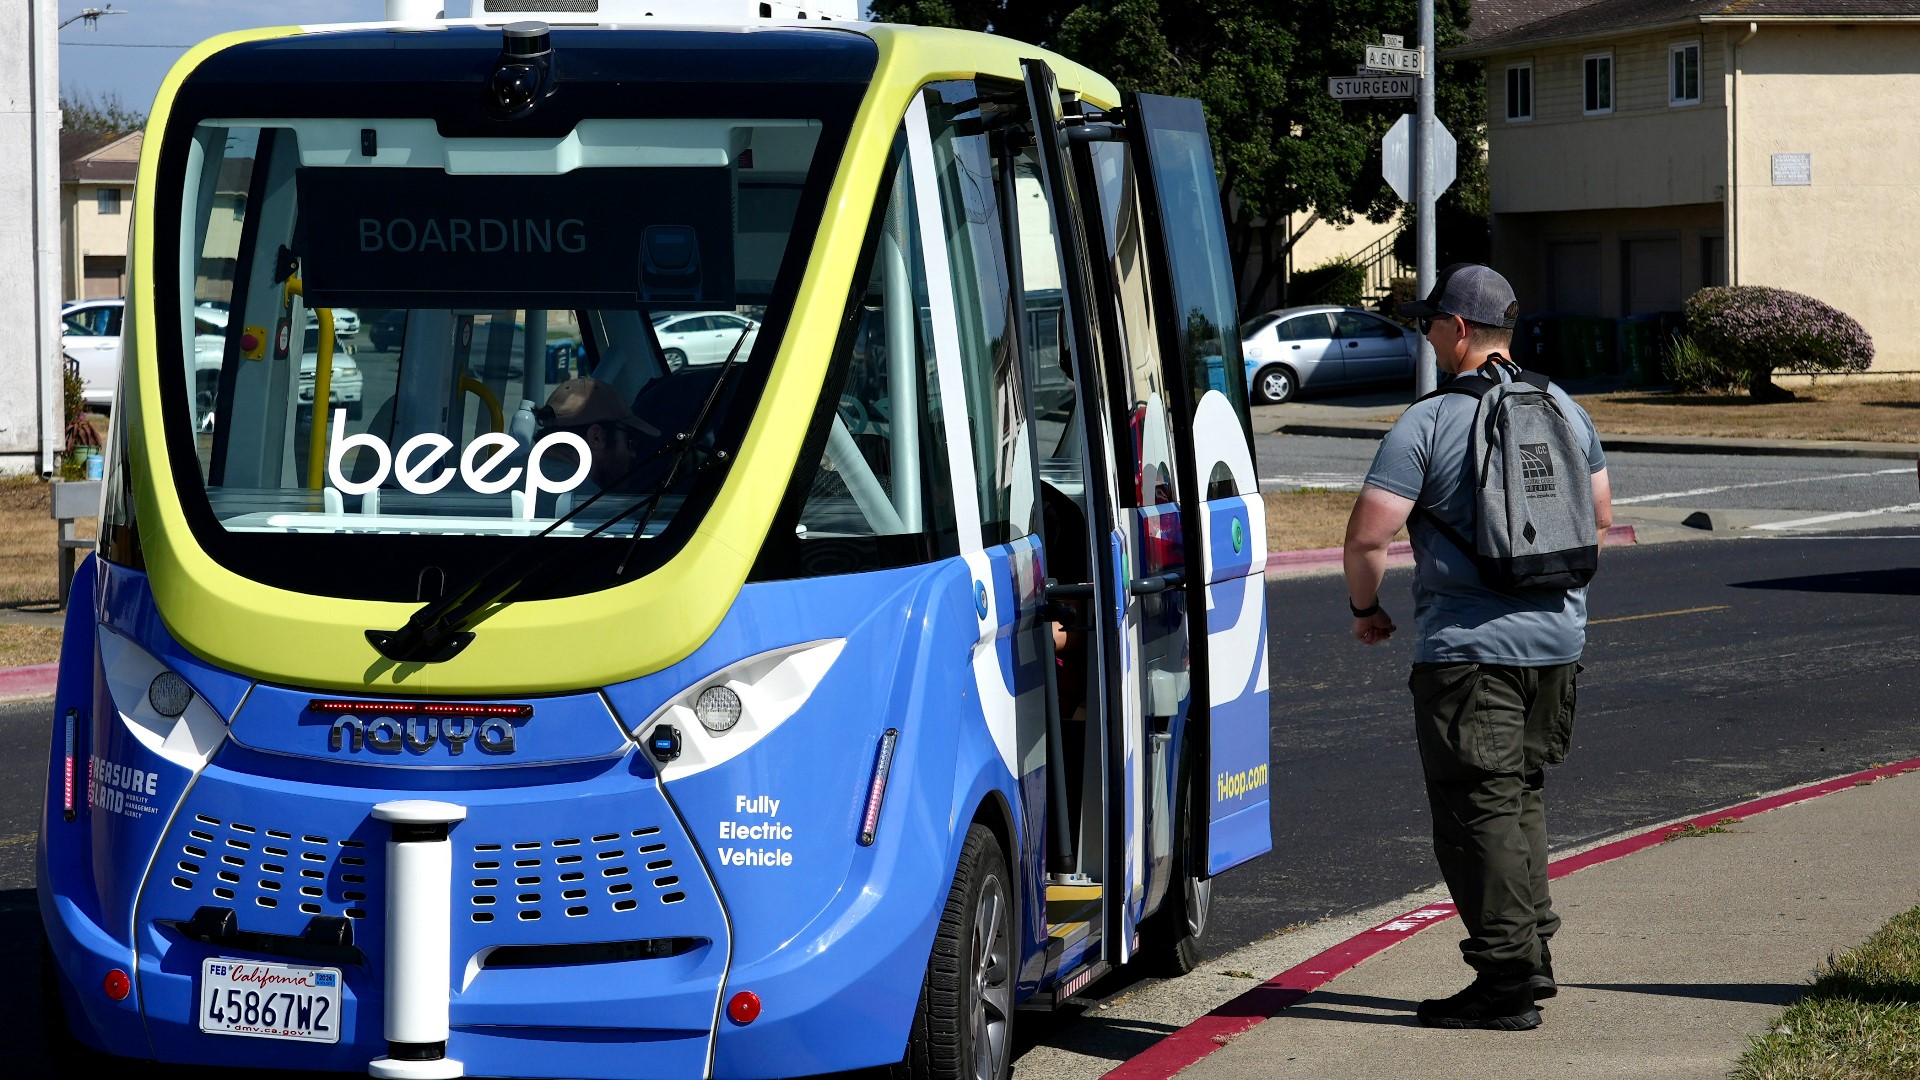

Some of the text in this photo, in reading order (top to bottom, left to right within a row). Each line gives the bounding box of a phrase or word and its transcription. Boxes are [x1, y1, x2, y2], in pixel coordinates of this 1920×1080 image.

[1412, 53, 1419, 68] B
[1336, 81, 1408, 95] STURGEON
[359, 218, 586, 253] BOARDING
[1535, 445, 1547, 455] ICC
[328, 408, 592, 519] beep
[1217, 763, 1268, 803] ti-loop.com
[124, 801, 159, 814] MANAGEMENT
[736, 795, 780, 817] Fully
[719, 821, 793, 840] Electric
[717, 847, 793, 867] Vehicle
[210, 964, 316, 989] FEB California
[209, 988, 330, 1031] 45867W2
[234, 1025, 305, 1036] dmv.ca.gov
